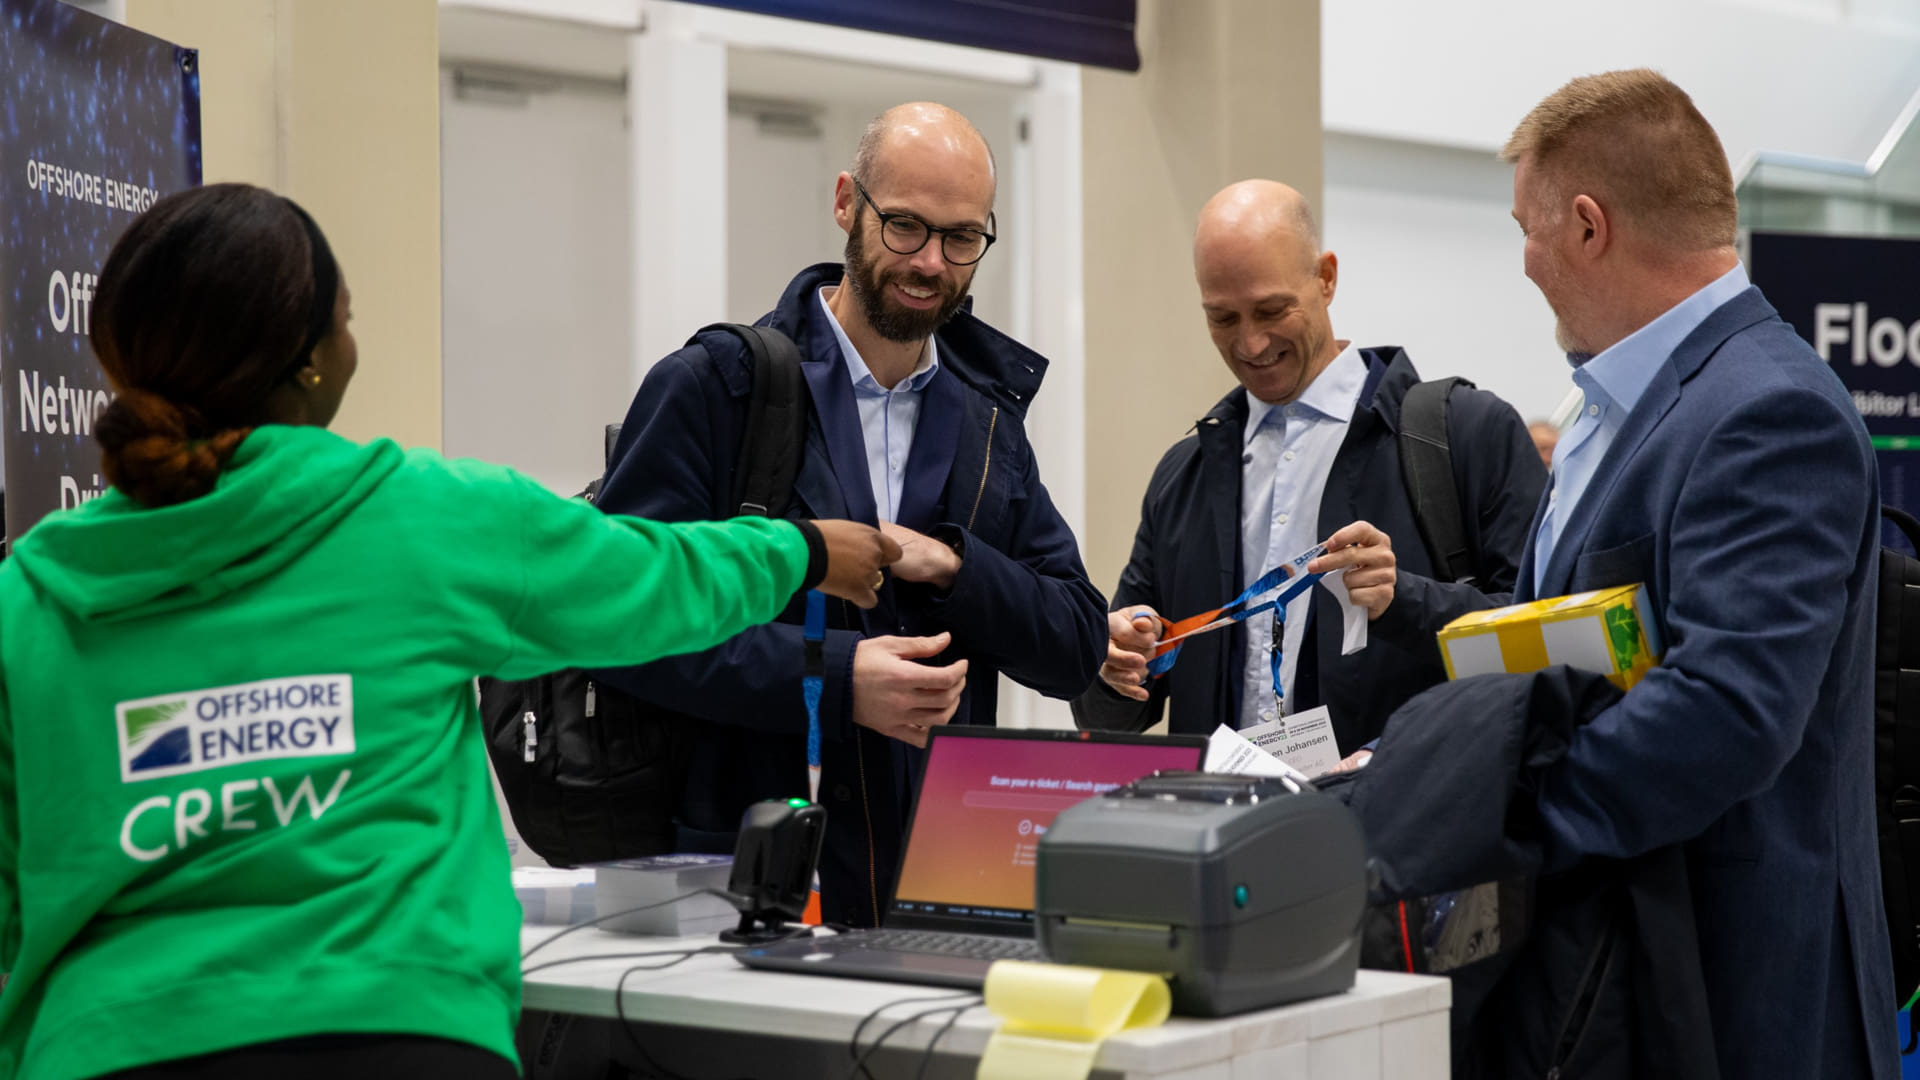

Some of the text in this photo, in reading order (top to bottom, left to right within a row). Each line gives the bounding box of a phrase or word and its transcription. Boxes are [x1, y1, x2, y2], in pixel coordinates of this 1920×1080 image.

[27, 159, 159, 213] OFFSHORE ENERGY
[19, 369, 116, 436] Netwo
[1850, 390, 1904, 416] isitor
[196, 682, 341, 722] OFFSHORE
[200, 716, 341, 762] ENERGY
[1257, 728, 1286, 741] OFFSHORE
[1271, 735, 1328, 758] en Johansen
[119, 769, 351, 862] CREW
